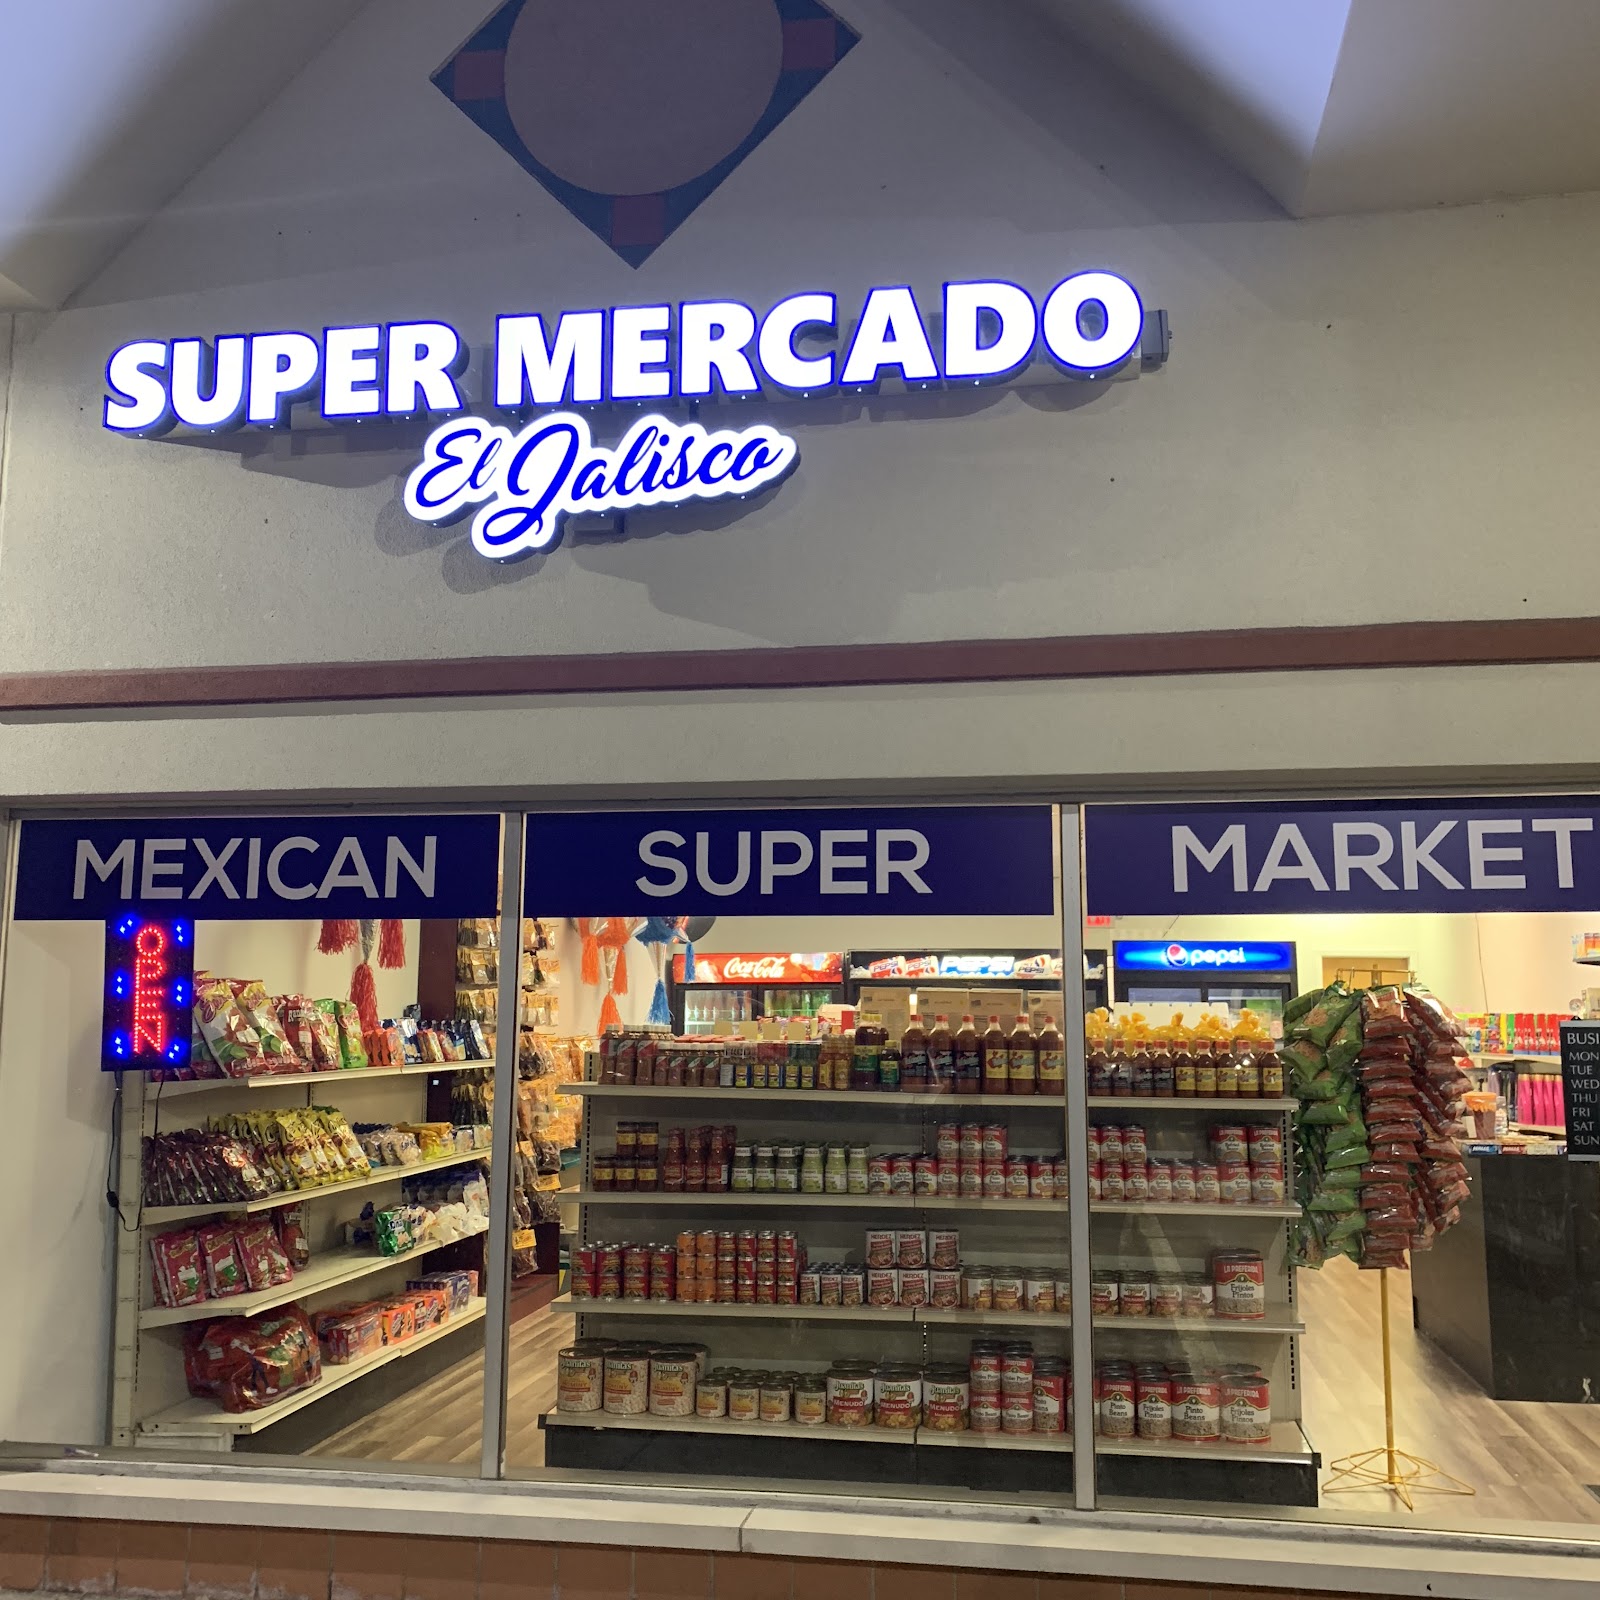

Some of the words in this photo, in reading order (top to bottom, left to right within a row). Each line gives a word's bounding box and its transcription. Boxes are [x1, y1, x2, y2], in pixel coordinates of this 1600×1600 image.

[104, 322, 461, 430] SUPER
[495, 270, 1142, 406] MERCADO
[416, 429, 502, 507] El
[483, 423, 784, 546] Jalisco
[636, 828, 933, 897] SUPER
[1171, 818, 1594, 893] MARKET
[74, 836, 437, 900] MEXICAN
[940, 956, 1015, 972] PEPSI
[1190, 947, 1246, 966] pepsi
[133, 925, 166, 1054] OPEN
[1569, 1051, 1600, 1061] MON
[1570, 1065, 1593, 1075] TUE
[1571, 1079, 1600, 1089] WED
[1572, 1093, 1598, 1103] THU
[1572, 1107, 1590, 1117] FRI
[1573, 1121, 1594, 1131] SAT
[1574, 1135, 1600, 1146] SUN
